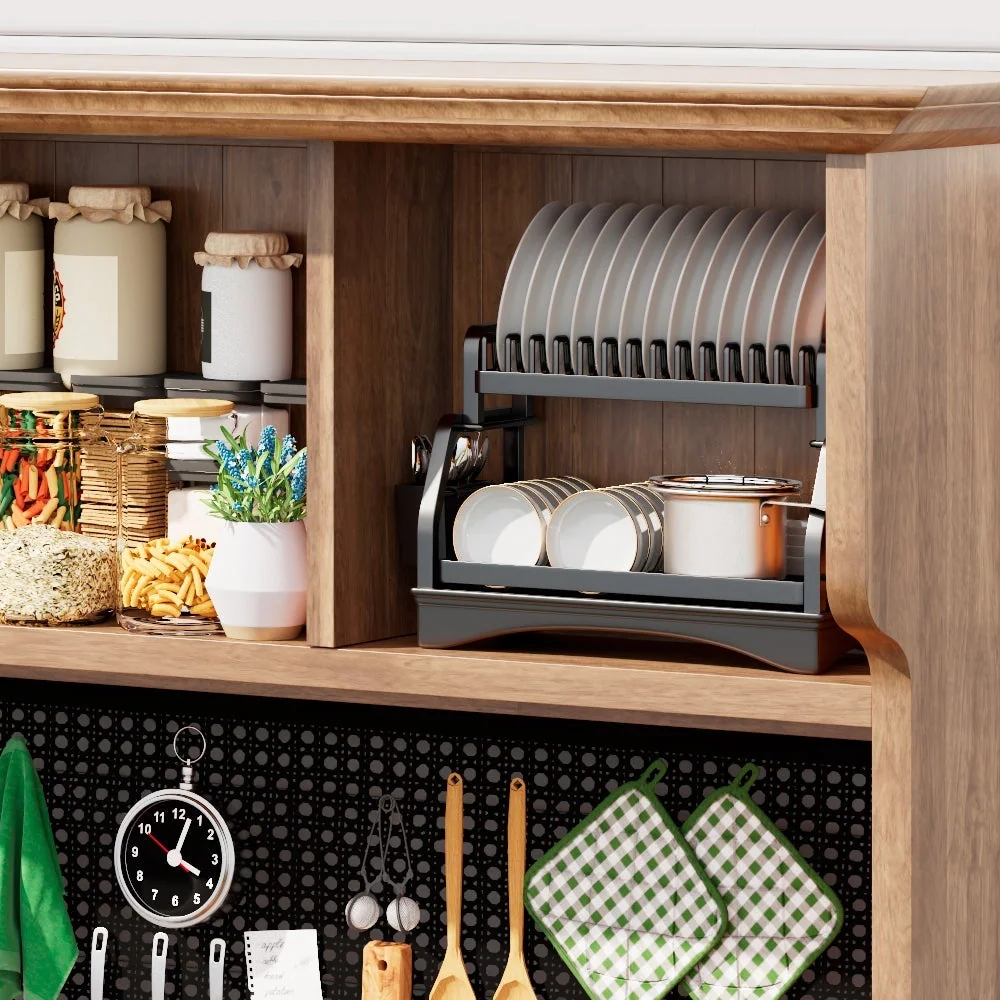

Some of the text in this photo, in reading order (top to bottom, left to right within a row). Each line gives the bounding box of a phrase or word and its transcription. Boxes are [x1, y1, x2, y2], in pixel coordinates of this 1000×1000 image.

[153, 811, 165, 823] 11
[171, 808, 186, 821] 12
[197, 815, 203, 827] 1
[138, 822, 152, 835] 10
[207, 829, 215, 841] 2
[131, 846, 139, 858] 9
[211, 854, 219, 866] 3
[136, 870, 144, 882] 8
[205, 877, 214, 890] 4
[151, 889, 159, 901] 7
[171, 895, 179, 907] 6
[193, 893, 201, 905] 5
